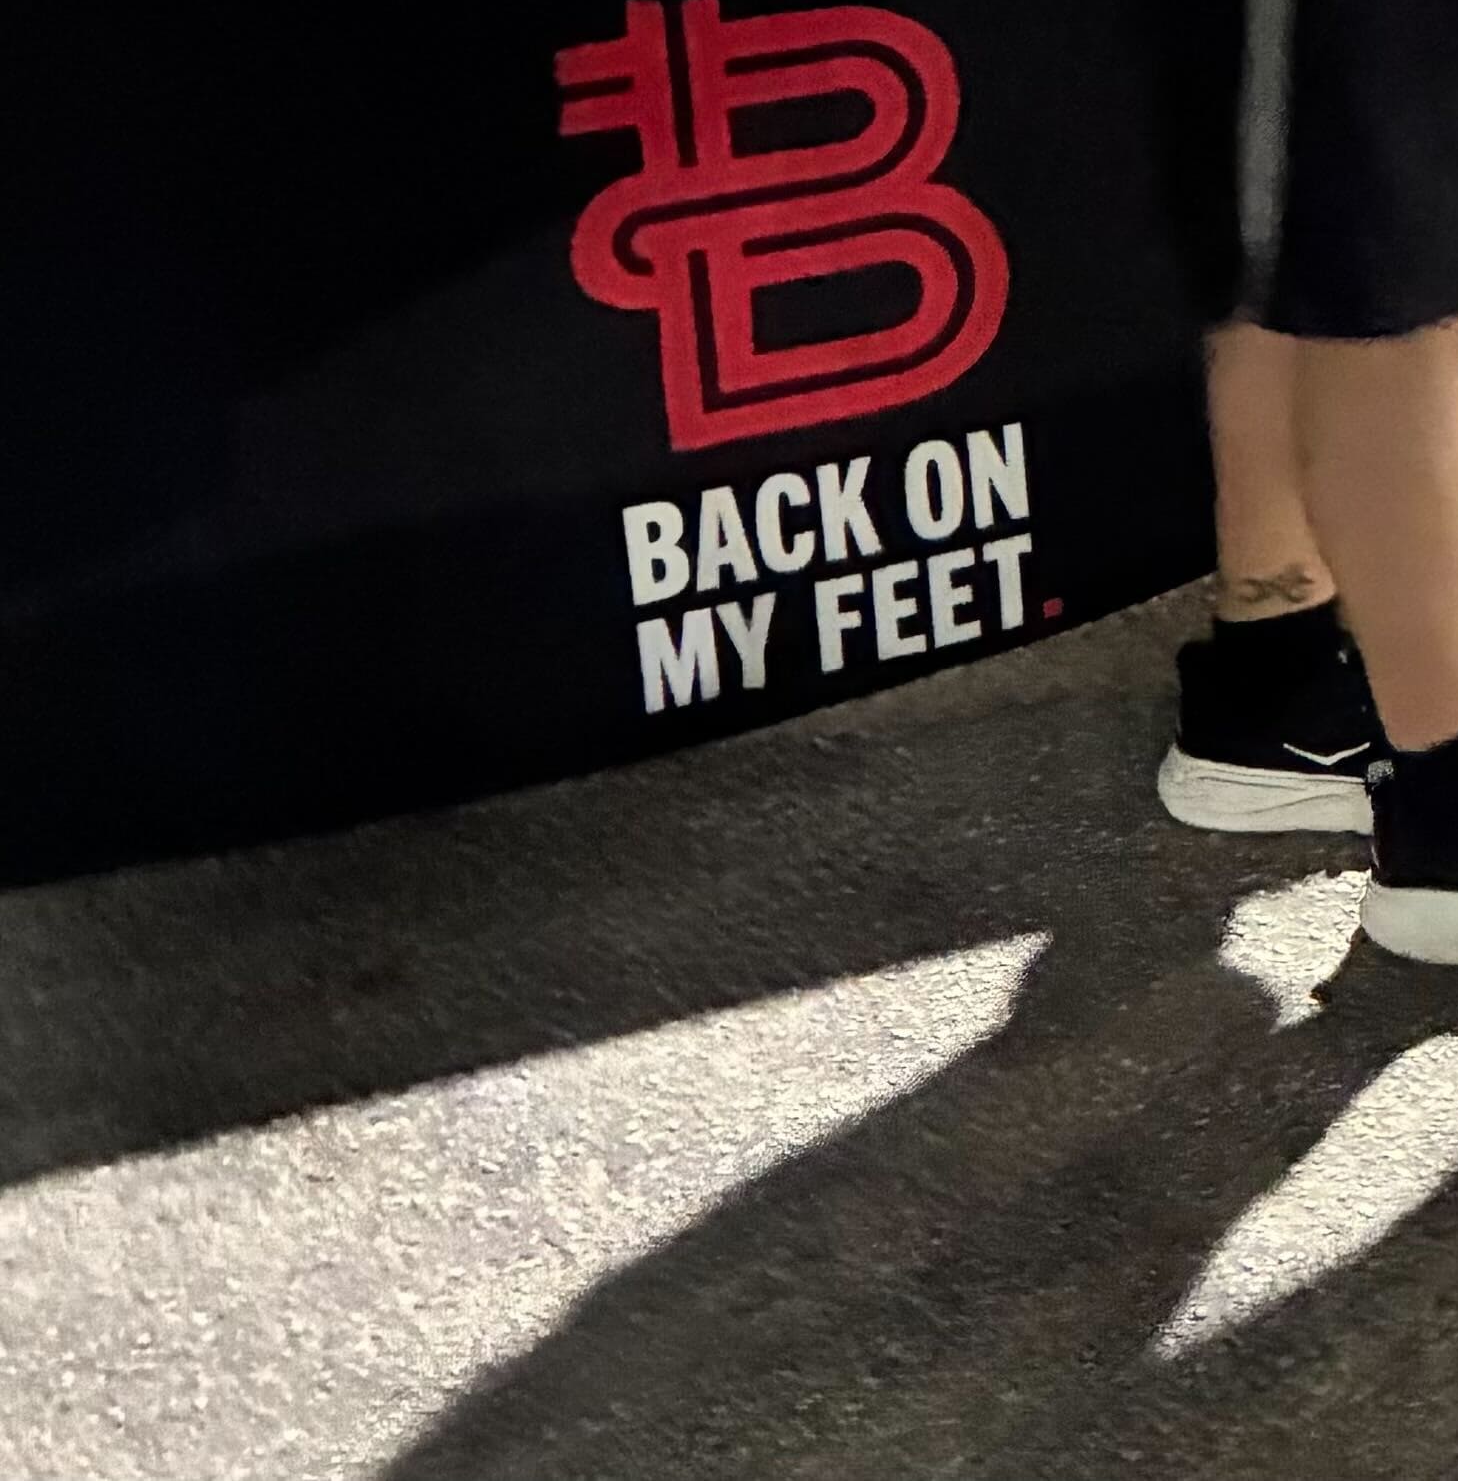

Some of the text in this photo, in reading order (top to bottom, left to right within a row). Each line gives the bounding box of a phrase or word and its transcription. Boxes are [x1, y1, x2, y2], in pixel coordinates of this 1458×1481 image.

[623, 422, 1029, 605] BACK ON
[634, 594, 776, 714] MY
